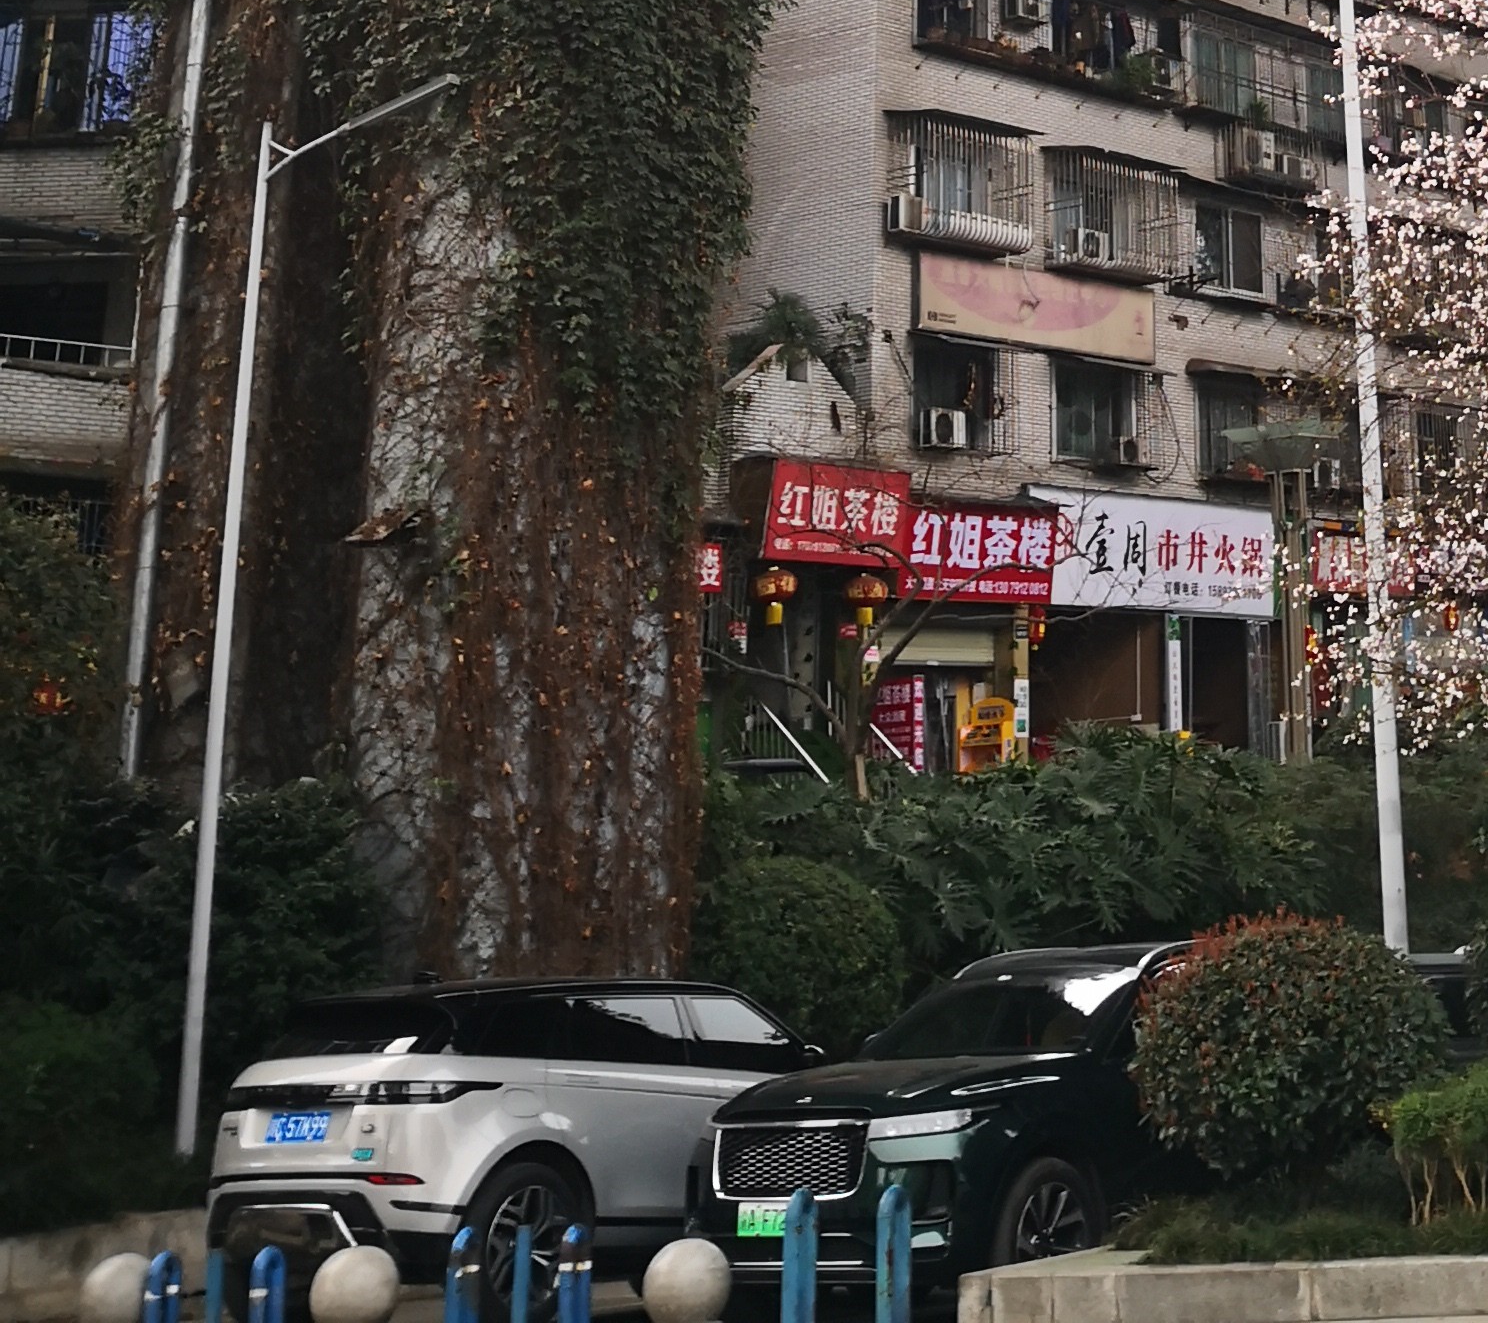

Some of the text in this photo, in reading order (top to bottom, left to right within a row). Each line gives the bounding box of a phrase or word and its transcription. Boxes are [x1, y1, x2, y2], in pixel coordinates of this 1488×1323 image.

[777, 481, 900, 536] 红姐茶楼
[910, 509, 1052, 573] 红姐茶楼
[1157, 529, 1263, 579] 市井火锅
